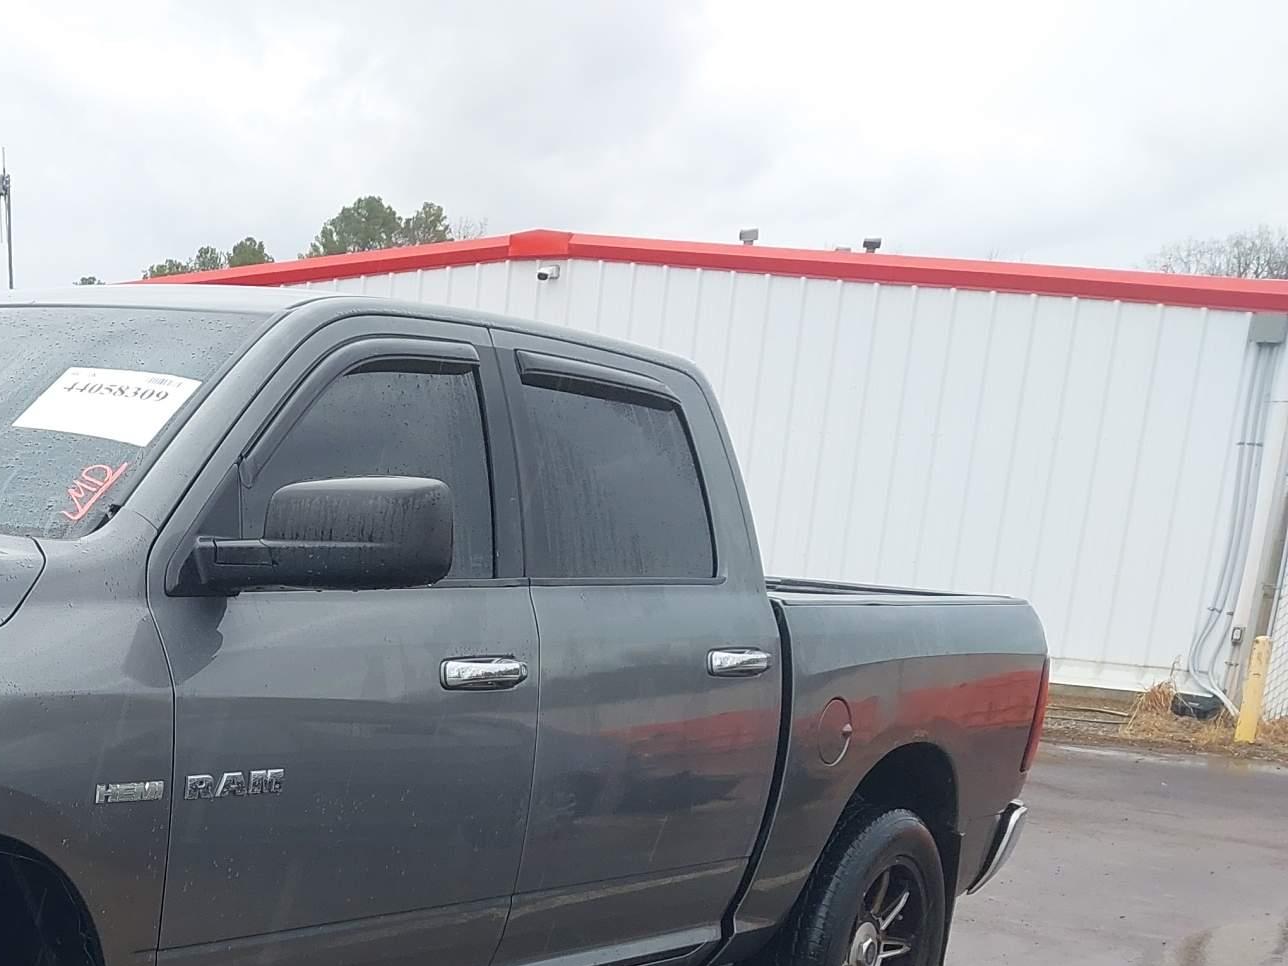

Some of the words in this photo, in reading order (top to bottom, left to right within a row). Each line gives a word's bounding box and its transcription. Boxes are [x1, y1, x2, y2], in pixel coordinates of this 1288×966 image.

[63, 381, 169, 402] 44058309
[95, 781, 164, 804] HEMI
[184, 769, 285, 801] RAM
